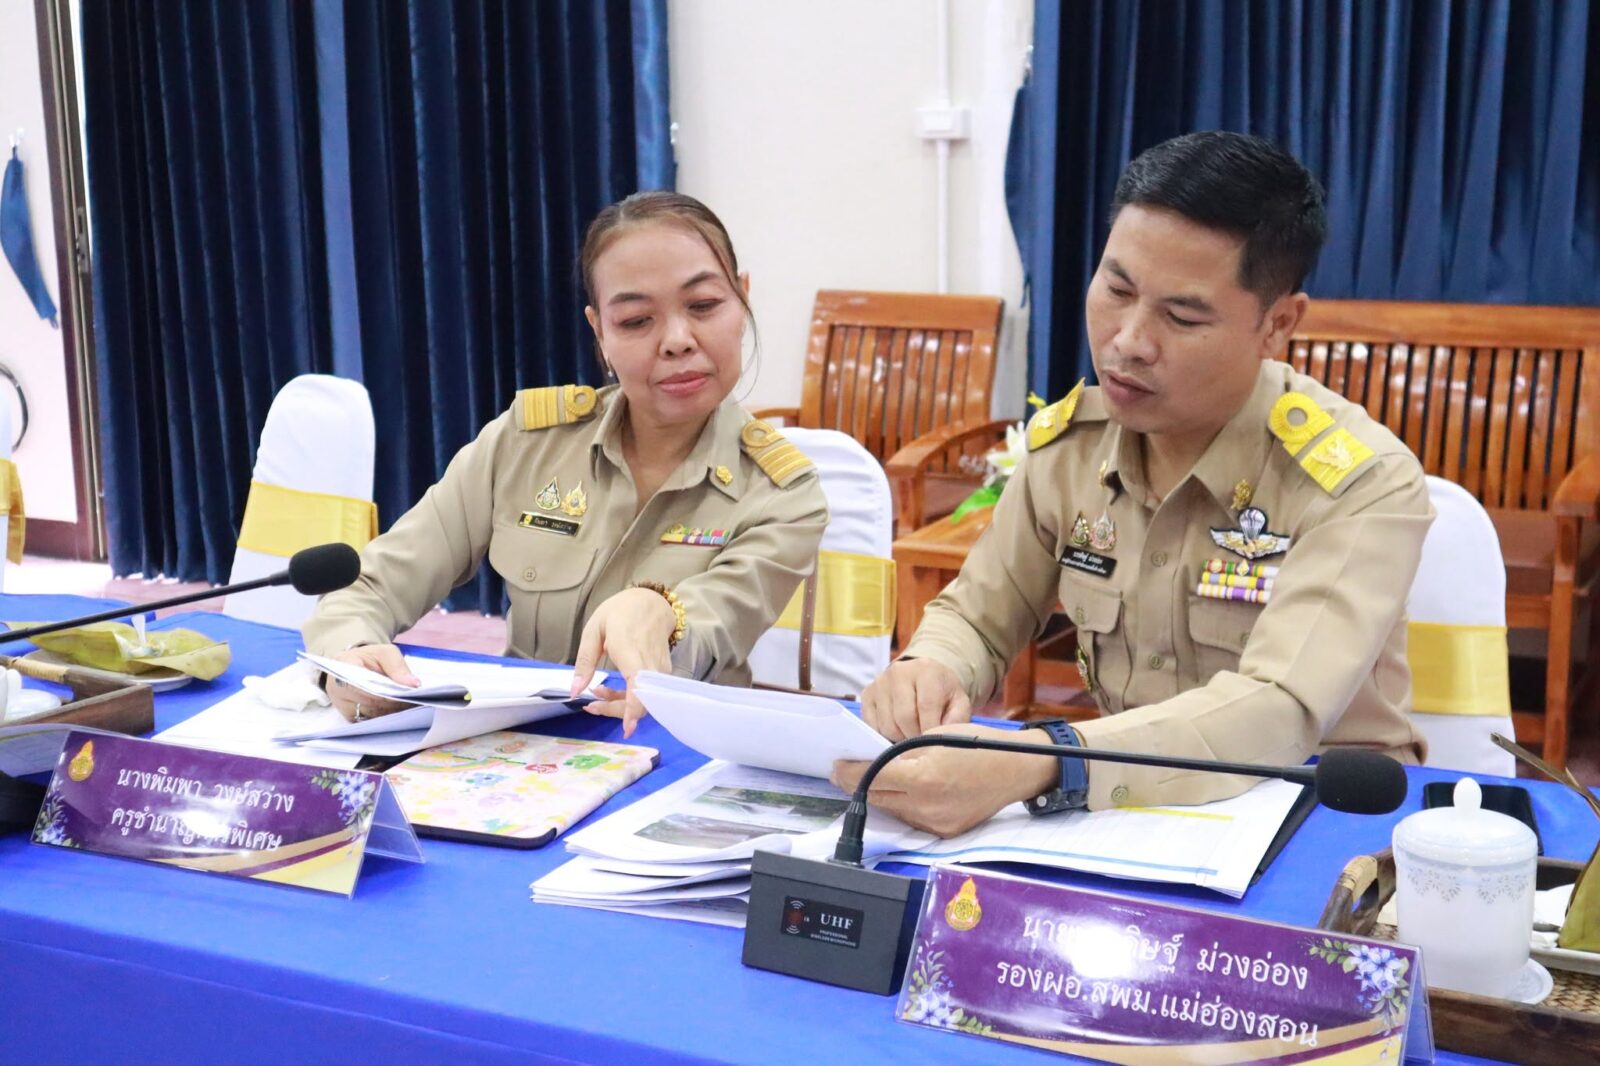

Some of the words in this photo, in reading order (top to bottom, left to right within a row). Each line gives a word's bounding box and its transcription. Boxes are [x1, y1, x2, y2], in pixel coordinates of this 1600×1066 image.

[117, 766, 202, 798] นางพิมพา
[213, 781, 295, 813] วงษ์สว่าง
[820, 913, 853, 929] UHF
[1196, 941, 1309, 991] ม่วงอ่อง
[997, 961, 1318, 1048] รองผอ.สพม.แม่ฮ่องสอน
